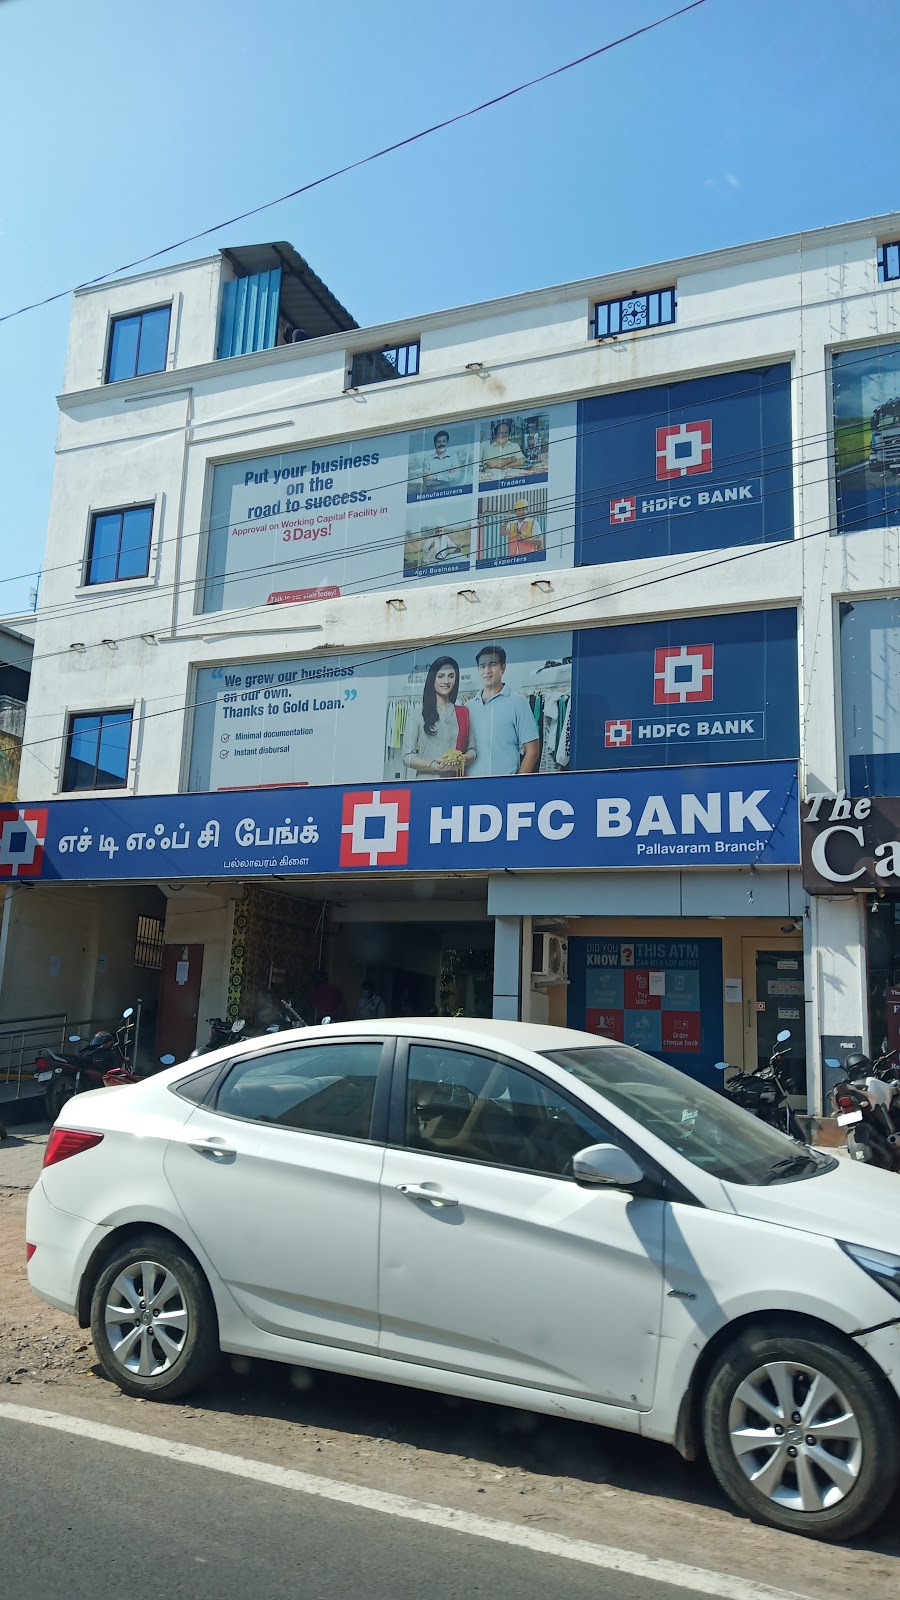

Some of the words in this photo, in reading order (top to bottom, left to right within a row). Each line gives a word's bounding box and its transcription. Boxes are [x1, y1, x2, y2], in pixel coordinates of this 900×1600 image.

[244, 468, 269, 486] Put
[273, 464, 306, 485] your
[311, 452, 380, 475] business
[286, 482, 304, 496] on
[309, 476, 334, 492] the
[500, 478, 526, 487] Traders
[416, 488, 463, 500] Manufacturers
[641, 495, 692, 513] HDFC
[697, 485, 753, 506] BANK
[247, 499, 281, 519] road
[285, 498, 300, 513] to
[305, 489, 372, 511] success.
[231, 525, 267, 537] Approval
[269, 523, 279, 531] on
[281, 517, 315, 529] Working
[316, 511, 346, 524] Capital
[347, 507, 378, 519] Facility
[380, 506, 388, 514] in
[429, 565, 459, 574] Business
[317, 589, 337, 598] today!
[245, 673, 275, 688] grew
[277, 670, 298, 682] our
[301, 665, 355, 680] business
[223, 692, 237, 703] on
[240, 688, 261, 702] our
[263, 688, 292, 700] own.
[222, 703, 265, 719] Thanks
[267, 702, 279, 715] to
[283, 699, 309, 714] Gold
[235, 731, 262, 741] Minimal
[263, 727, 314, 739] documentation
[638, 722, 691, 739] HDFC
[697, 719, 755, 736] BANK
[234, 747, 258, 757] Instant
[258, 744, 290, 755] disbursal
[803, 788, 872, 823] The
[429, 799, 575, 845] HDFC
[596, 789, 774, 840] BANK
[234, 815, 320, 847] பேங்க்
[636, 843, 711, 855] Pallavaram
[715, 839, 765, 853] Branch
[223, 855, 278, 869] பல்லாவரம்
[279, 854, 310, 867] கிளை
[586, 943, 600, 952] DID
[602, 943, 619, 952] YOU
[635, 943, 666, 958] THIS
[669, 943, 699, 958] ATM
[586, 954, 619, 966] KNOW
[637, 991, 648, 1000] Pay
[673, 1032, 689, 1040] Order
[684, 1039, 699, 1047] book
